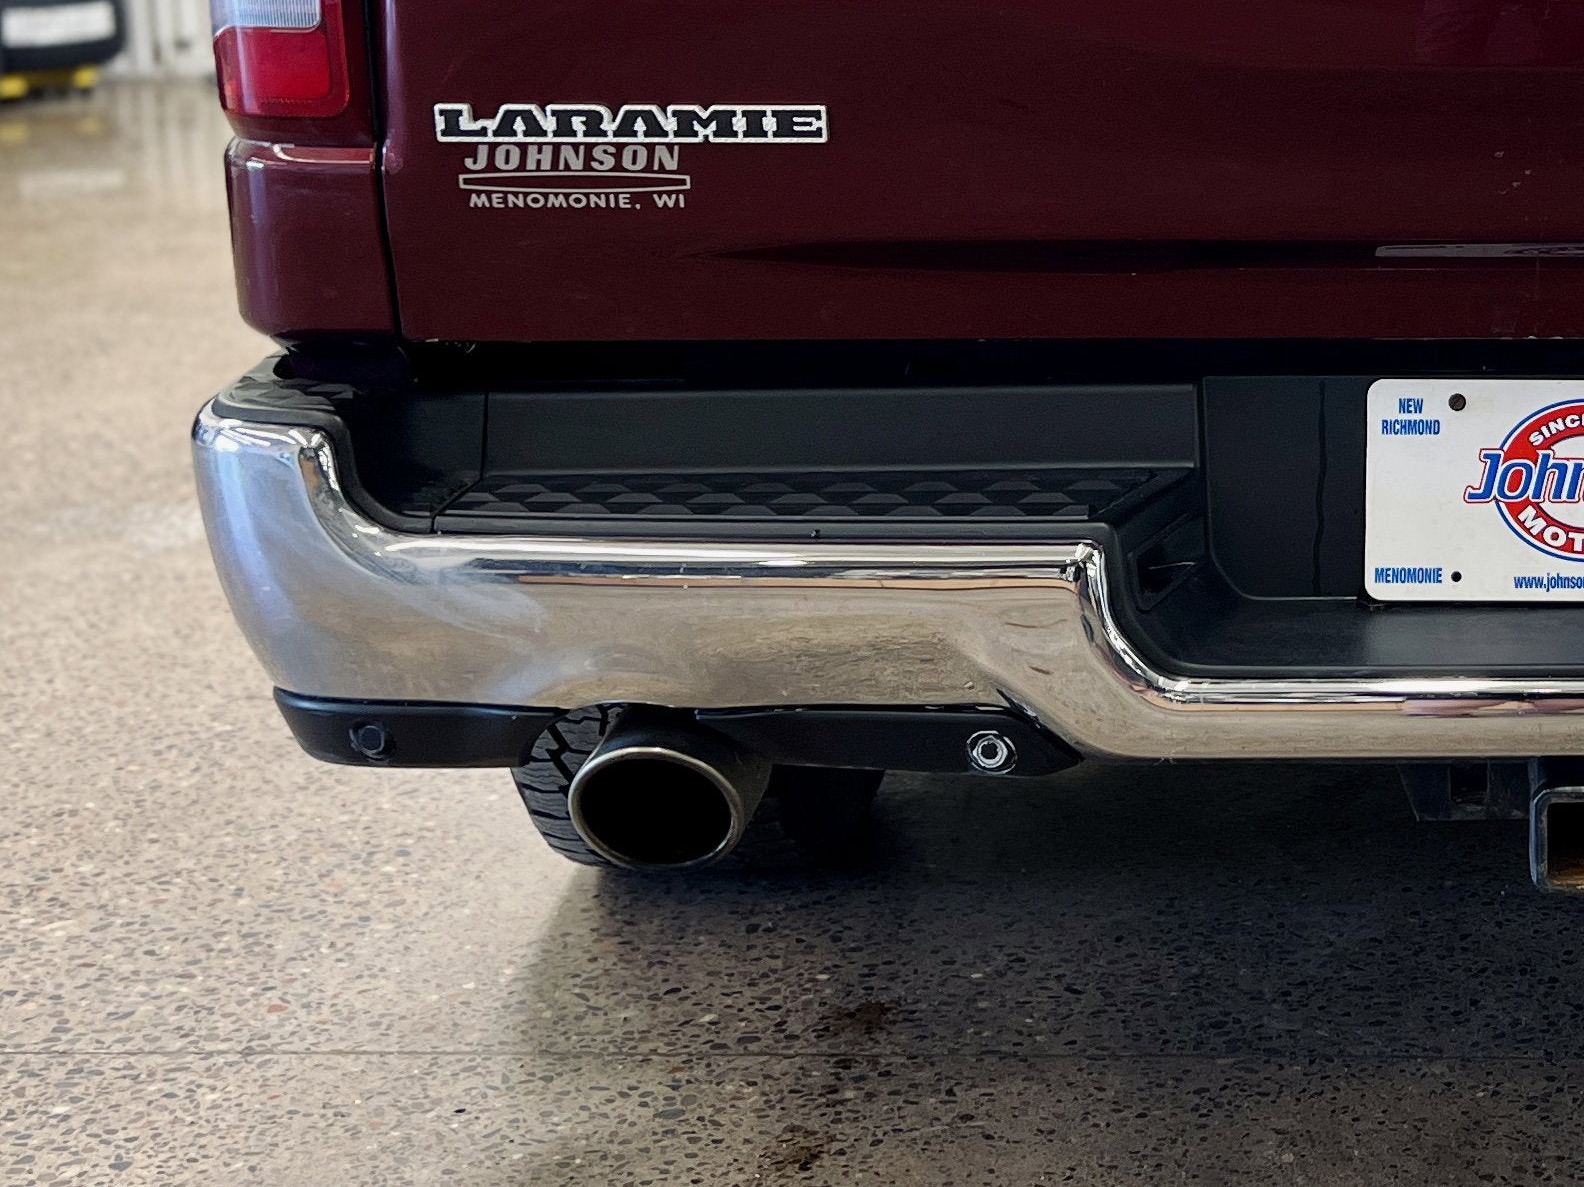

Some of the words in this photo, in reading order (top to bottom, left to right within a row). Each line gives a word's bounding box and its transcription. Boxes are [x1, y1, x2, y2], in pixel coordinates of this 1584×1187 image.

[434, 103, 829, 143] LARAMIE
[464, 144, 680, 171] JOHNSON
[653, 193, 686, 209] WI
[1398, 397, 1424, 414] NEW
[1381, 419, 1441, 436] RICHMOND
[1374, 567, 1443, 584] MENOMONIE
